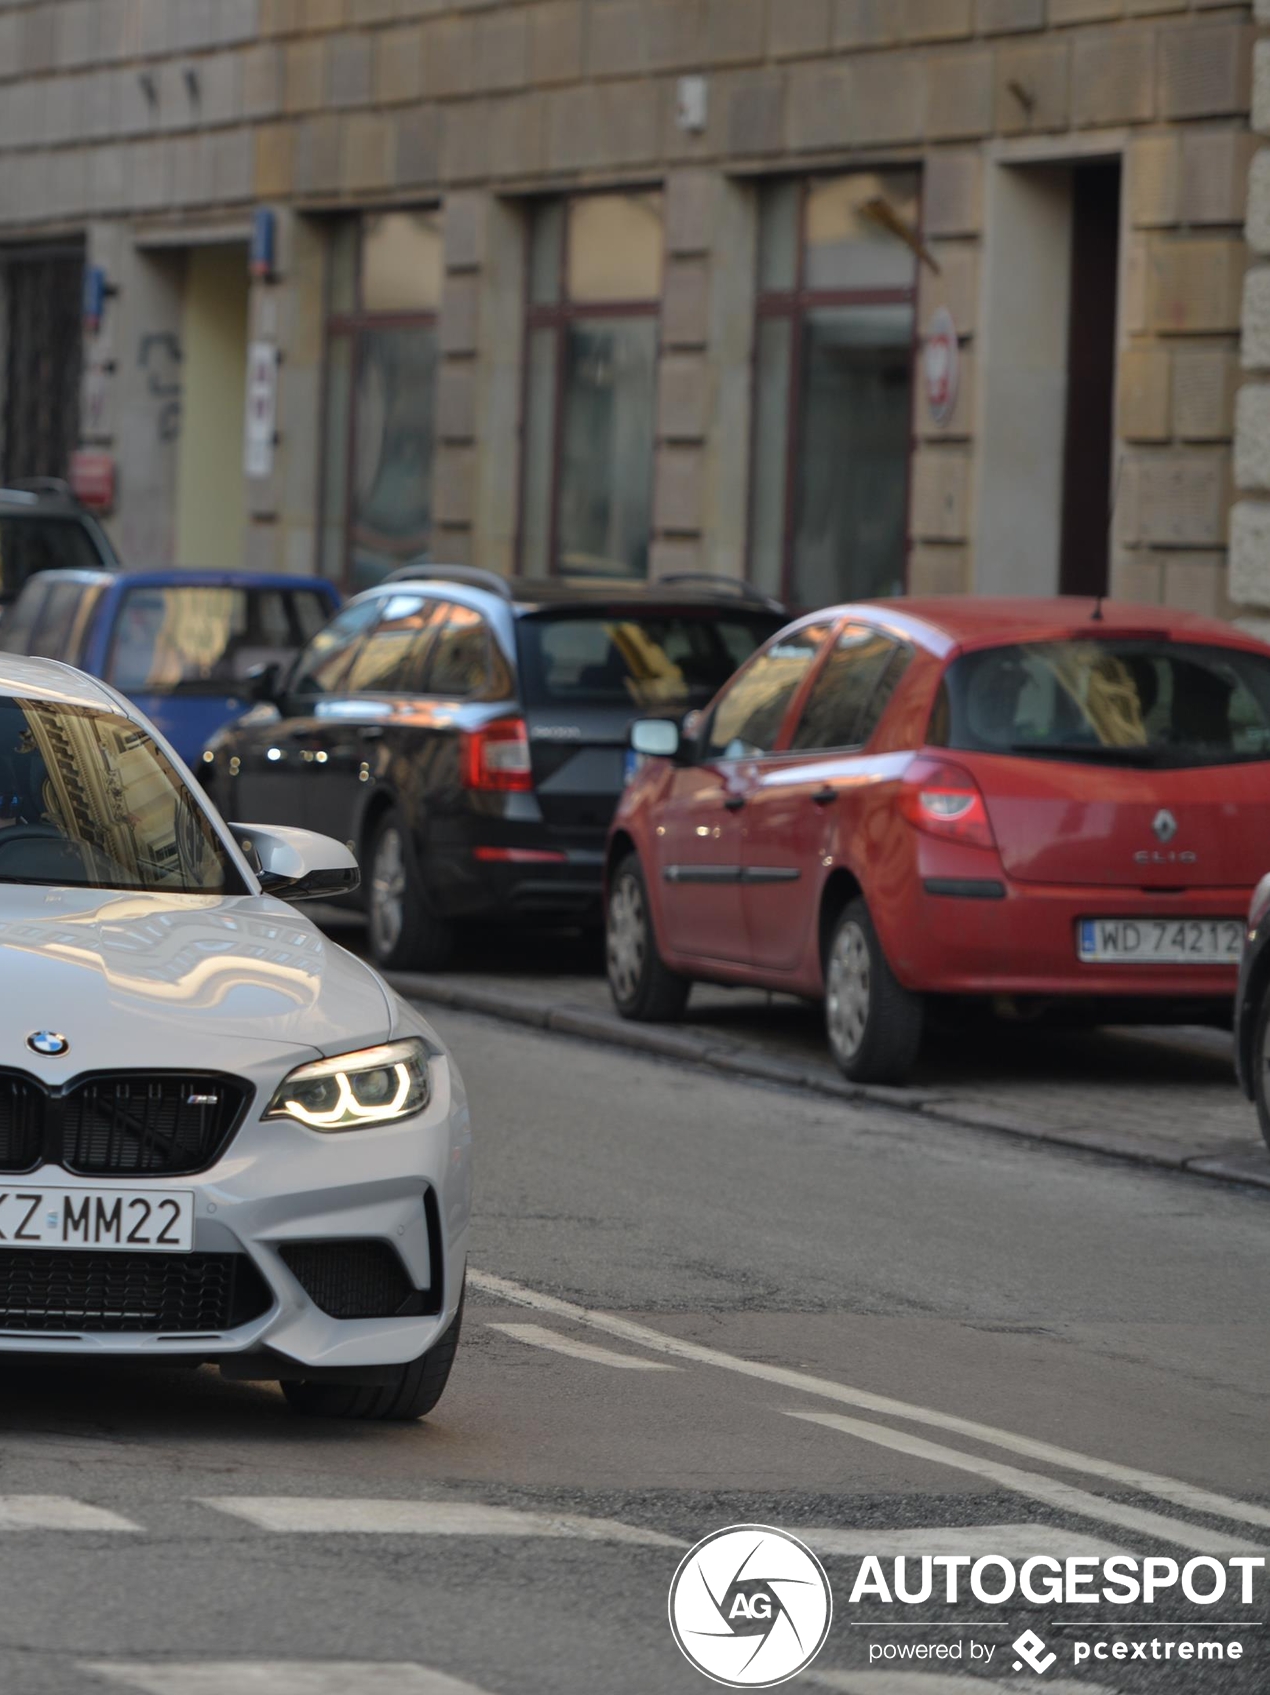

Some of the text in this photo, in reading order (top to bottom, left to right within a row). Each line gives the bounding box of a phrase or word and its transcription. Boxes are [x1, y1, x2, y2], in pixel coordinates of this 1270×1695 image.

[1134, 851, 1197, 864] CLIO
[1101, 922, 1240, 953] WD 74212
[62, 1195, 182, 1244] MM22
